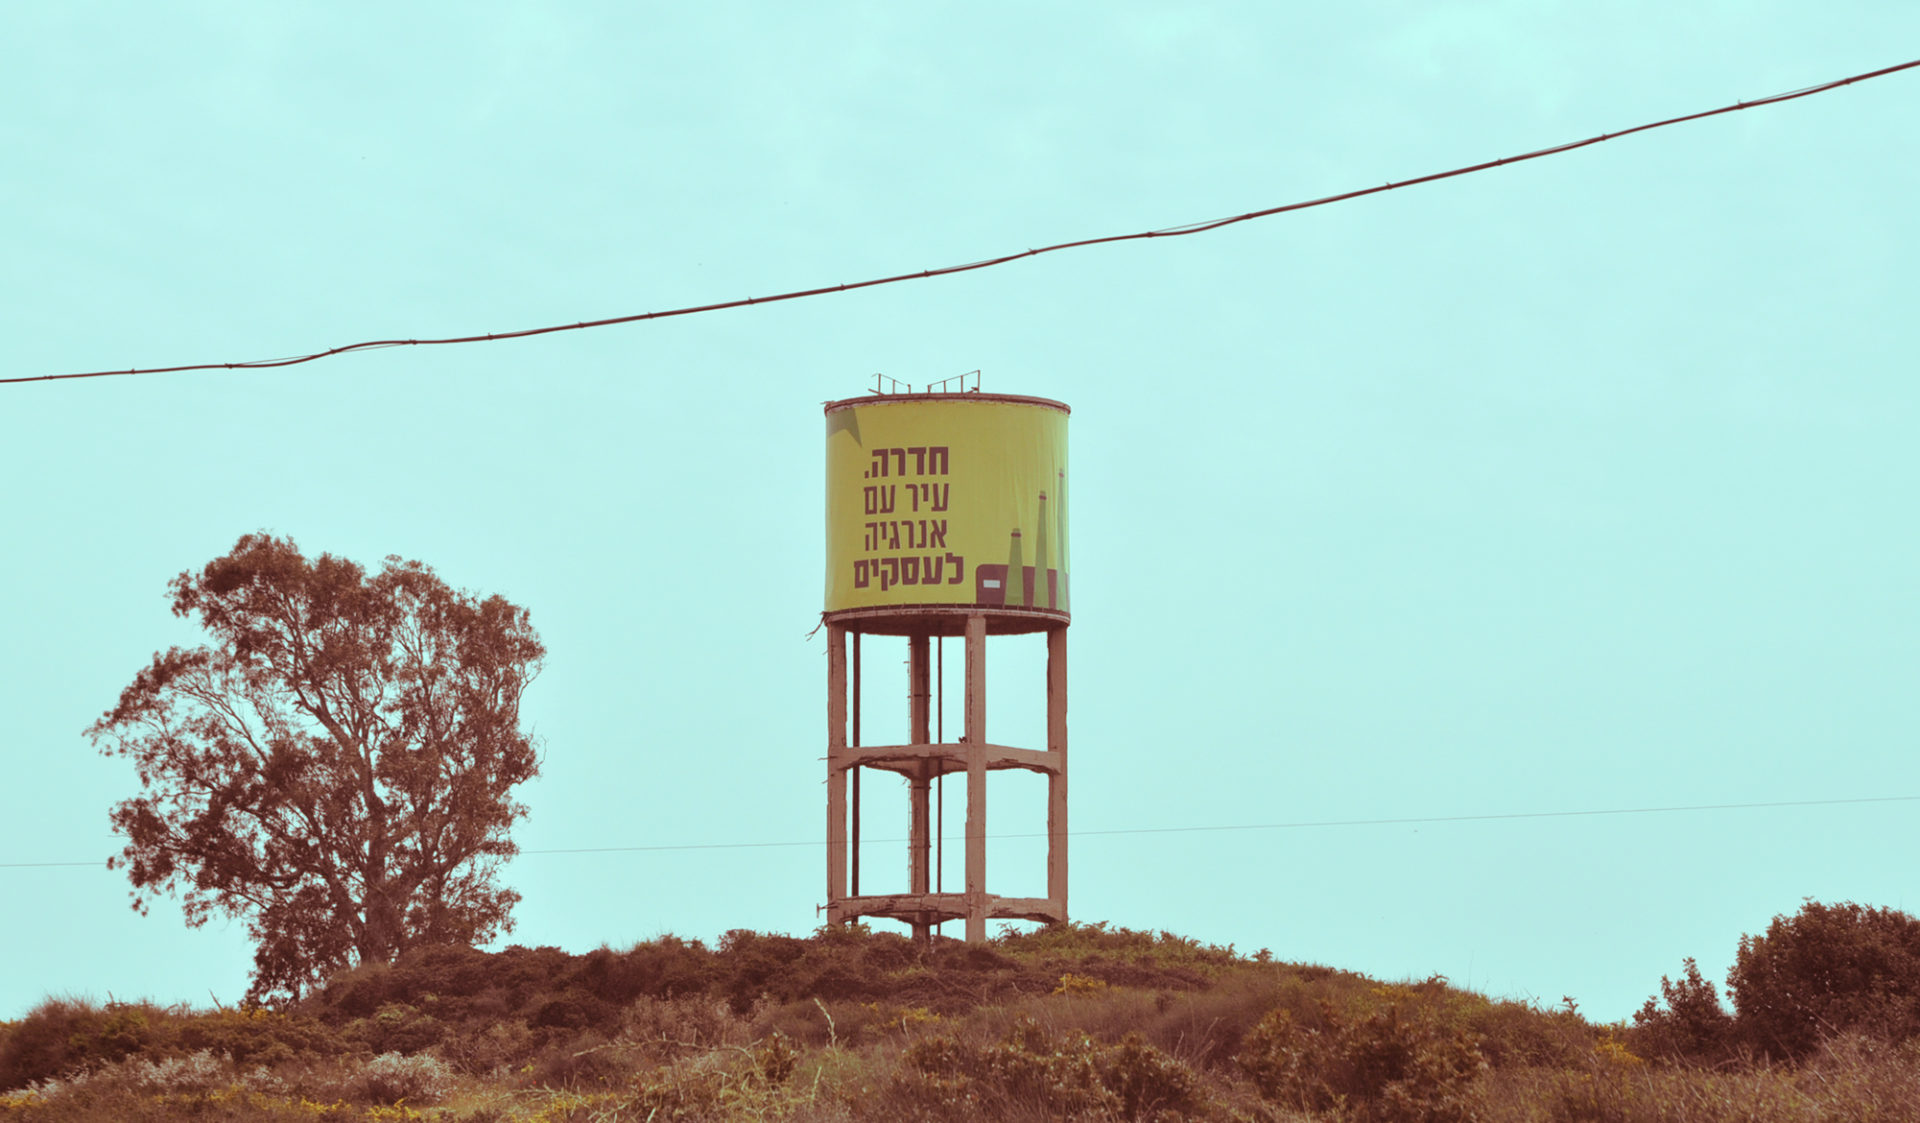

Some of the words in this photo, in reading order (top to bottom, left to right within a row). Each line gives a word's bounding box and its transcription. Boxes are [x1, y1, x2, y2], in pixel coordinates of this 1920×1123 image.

[863, 484, 897, 516] עם
[905, 482, 950, 513] עיר
[864, 519, 948, 553] אנרגיה
[853, 552, 965, 592] לעסקים
